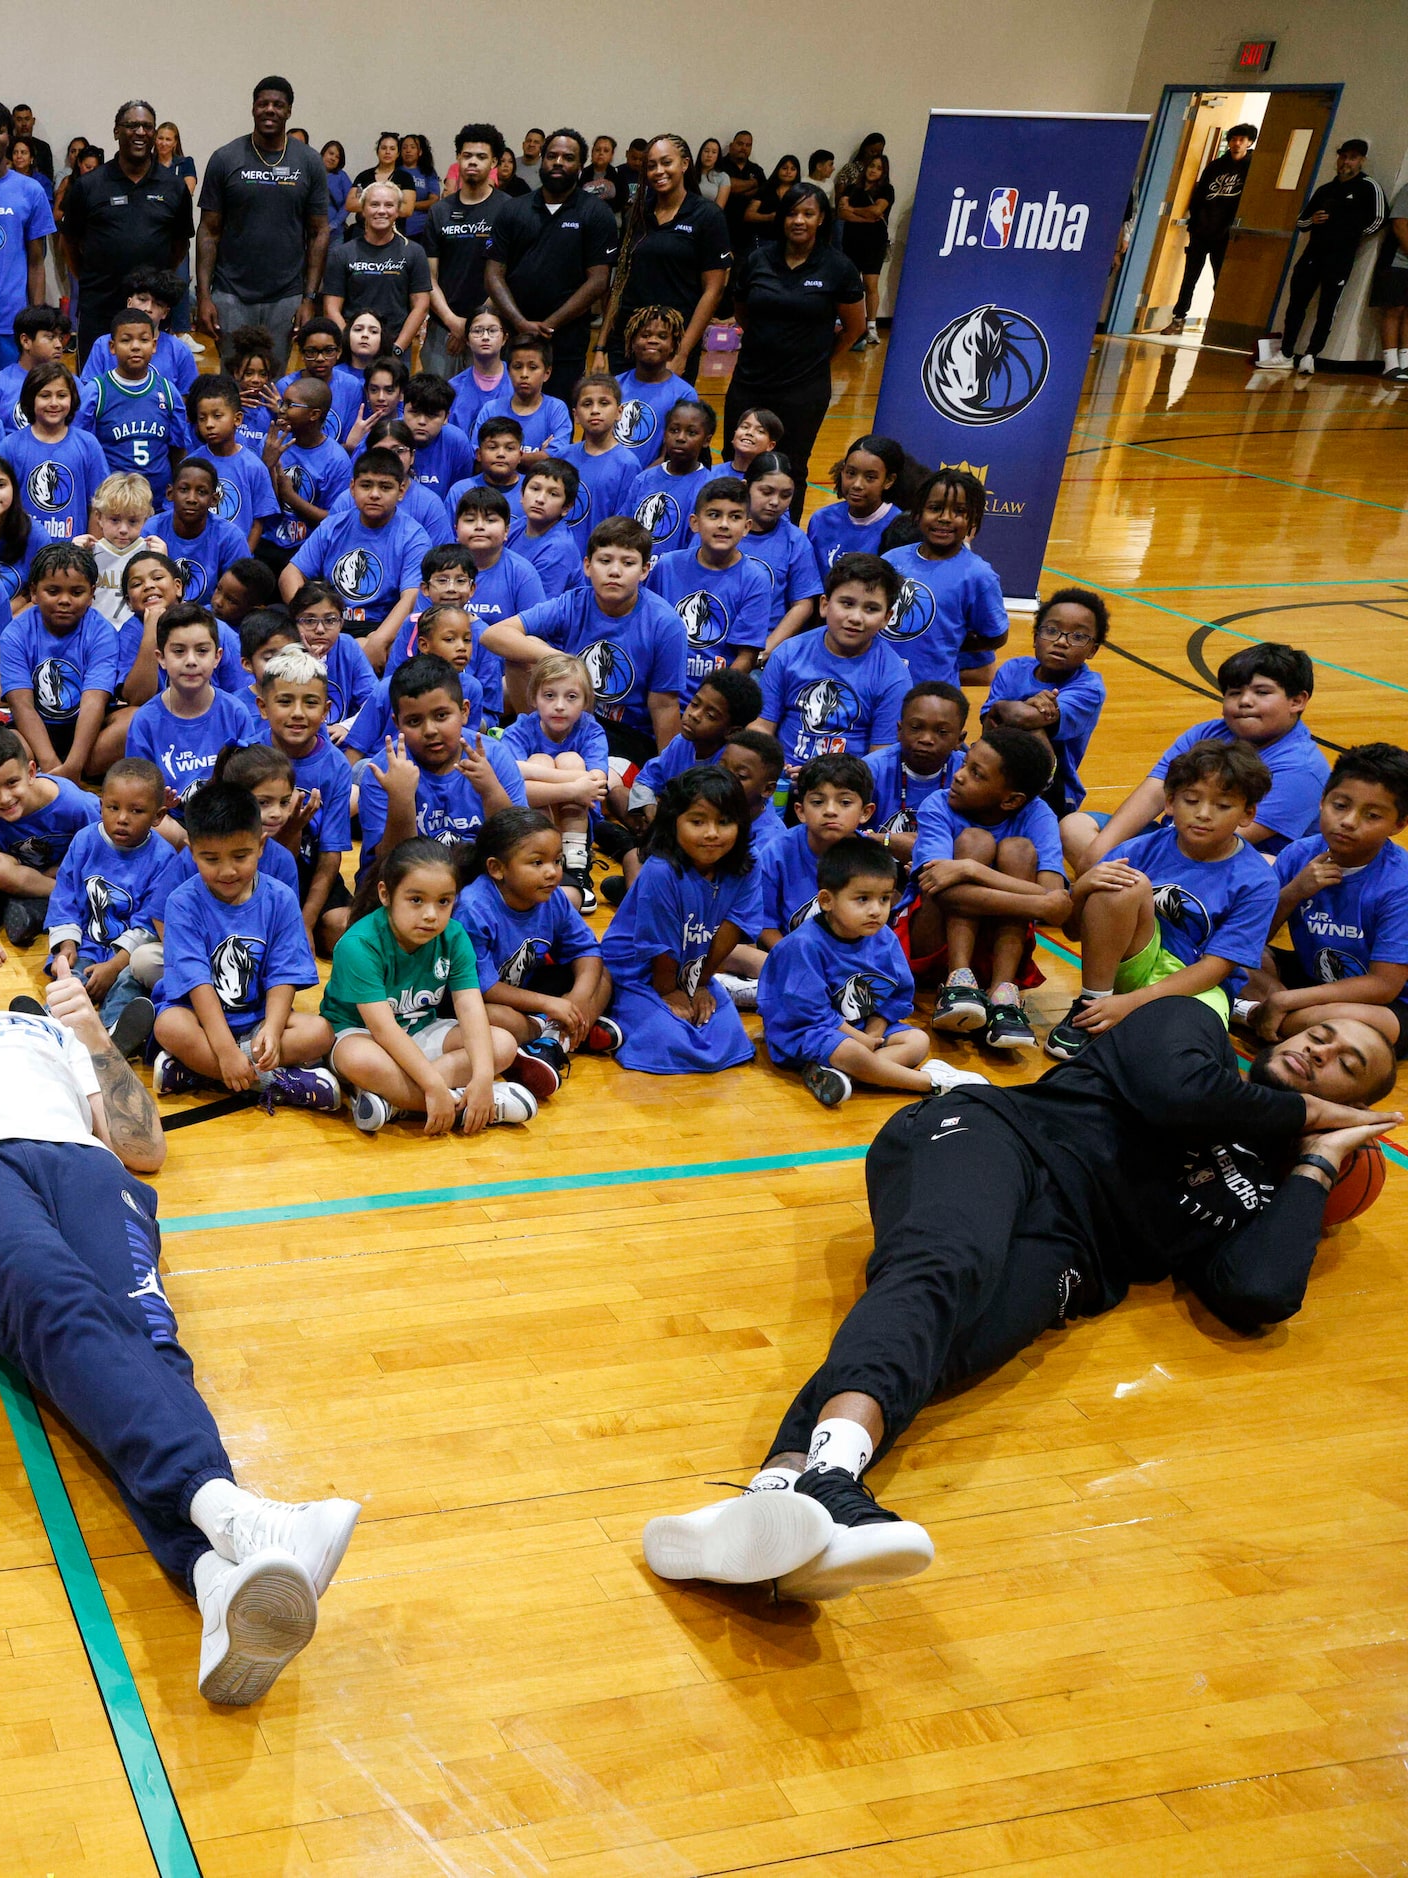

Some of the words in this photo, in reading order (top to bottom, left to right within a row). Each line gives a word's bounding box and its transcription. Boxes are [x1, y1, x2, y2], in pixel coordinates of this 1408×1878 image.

[1240, 43, 1265, 66] EXIT
[939, 187, 977, 257] jr.
[1012, 190, 1089, 252] nba
[112, 420, 166, 441] DALLAS
[133, 440, 150, 466] 5
[992, 498, 1027, 514] LAW
[686, 654, 714, 678] nba
[176, 751, 196, 761] JR.
[1307, 912, 1332, 922] JR.
